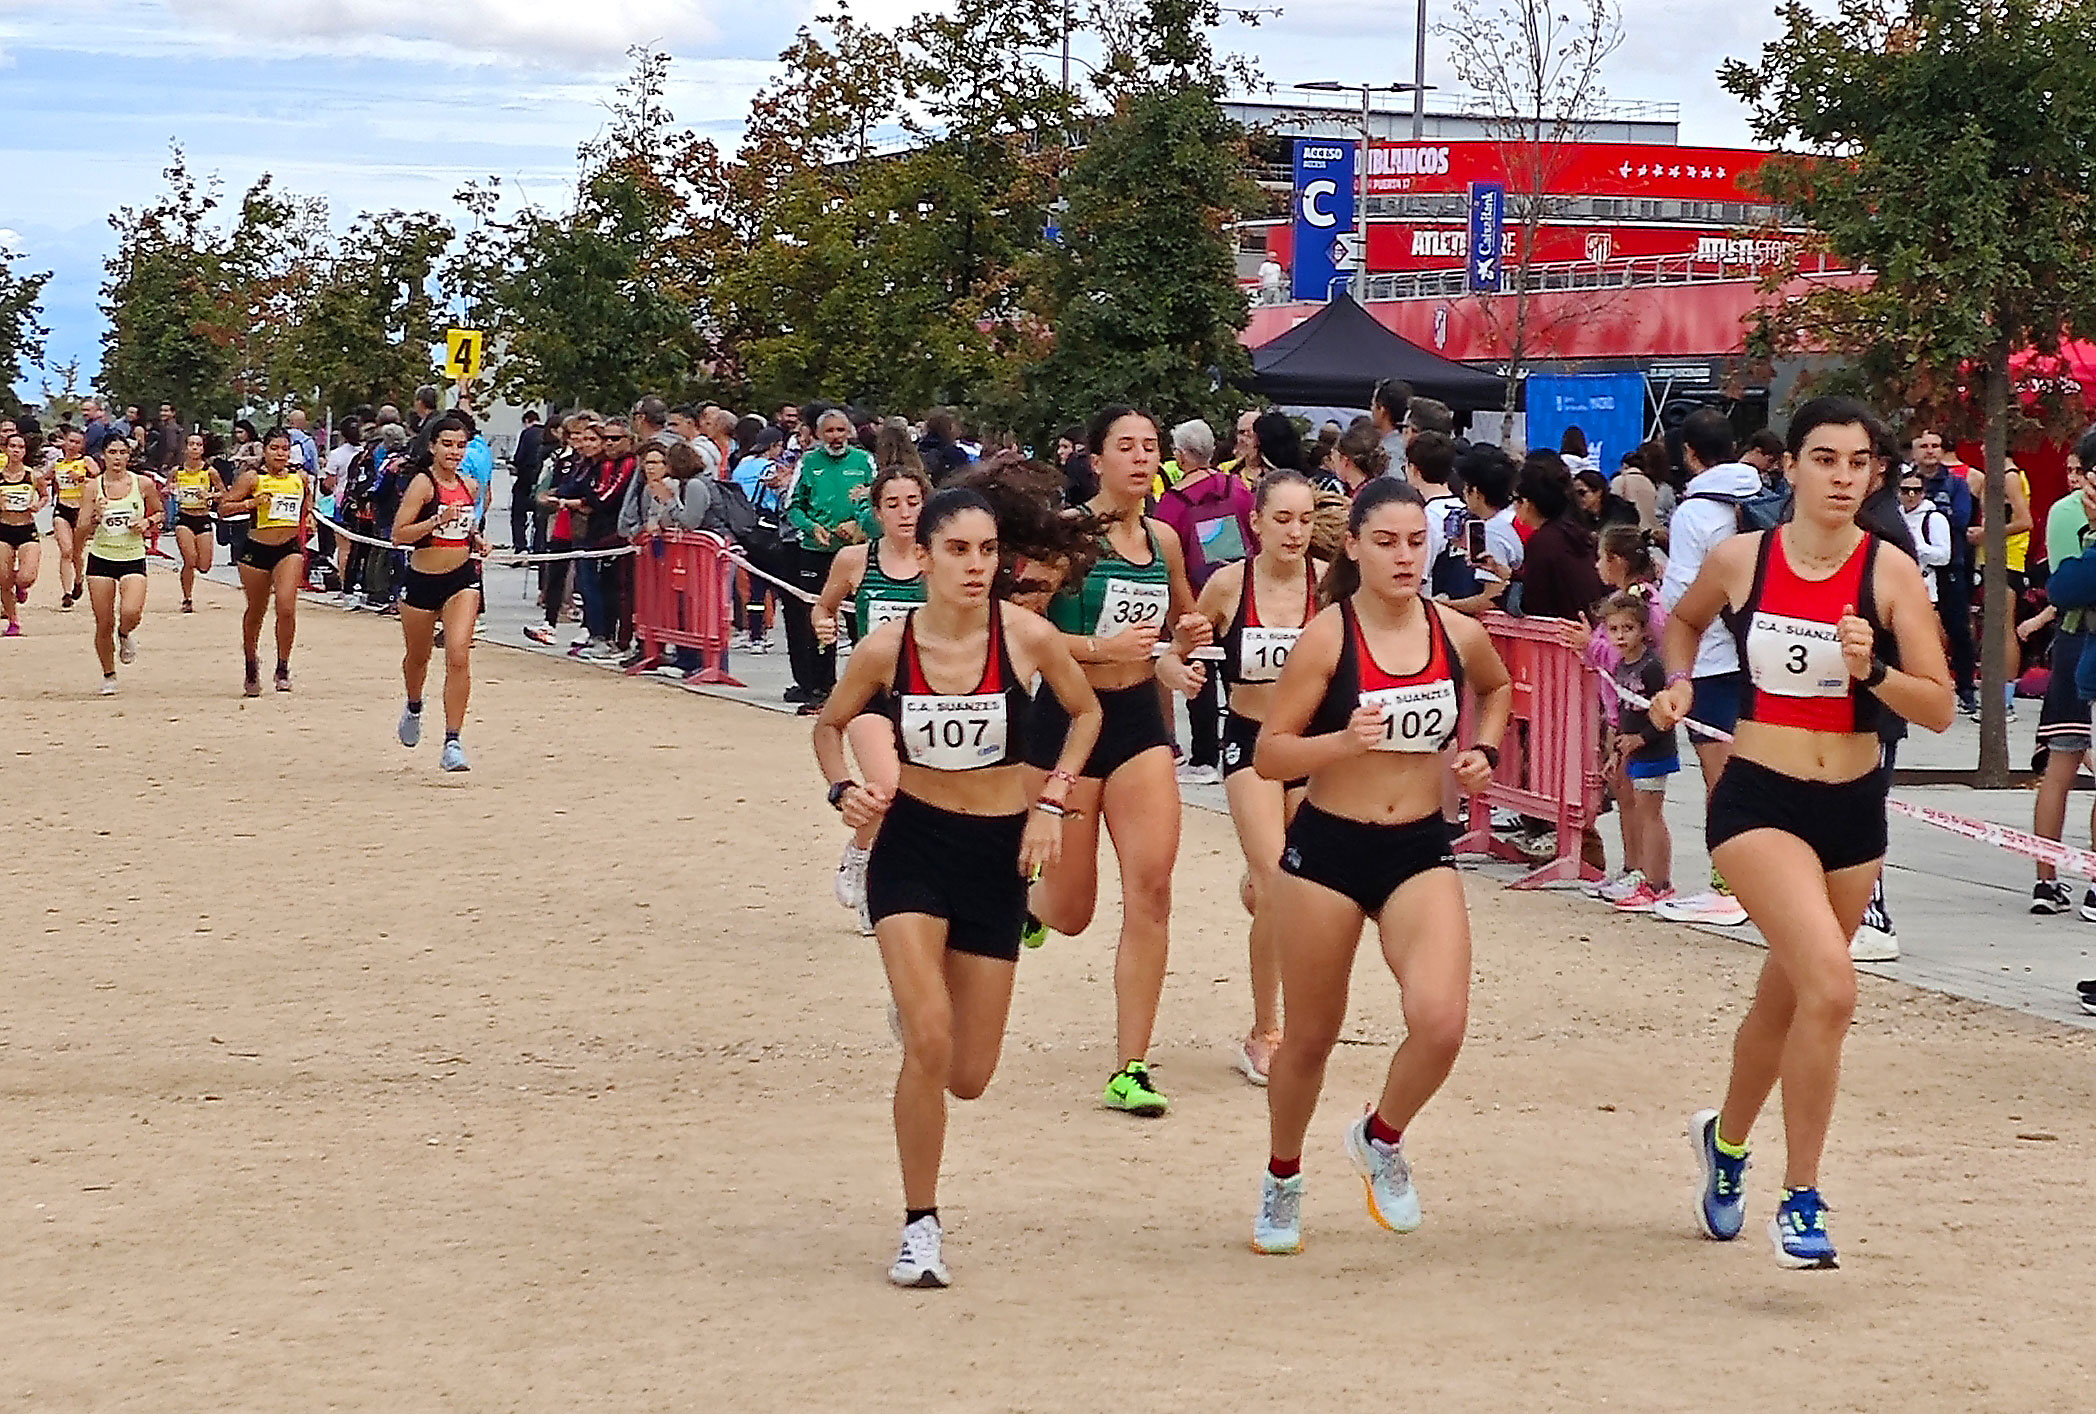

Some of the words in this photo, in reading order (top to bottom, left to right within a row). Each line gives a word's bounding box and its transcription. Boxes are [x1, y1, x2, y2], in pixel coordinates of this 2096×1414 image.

[1303, 147, 1343, 160] ACCESO
[1302, 180, 1336, 227] C
[454, 338, 471, 373] 4
[106, 516, 131, 528] 657
[1113, 600, 1158, 623] 332
[1757, 620, 1781, 633] C.A.
[1256, 646, 1288, 668] 10
[1786, 644, 1808, 674] 3
[919, 719, 990, 748] 107
[1380, 708, 1442, 740] 102
